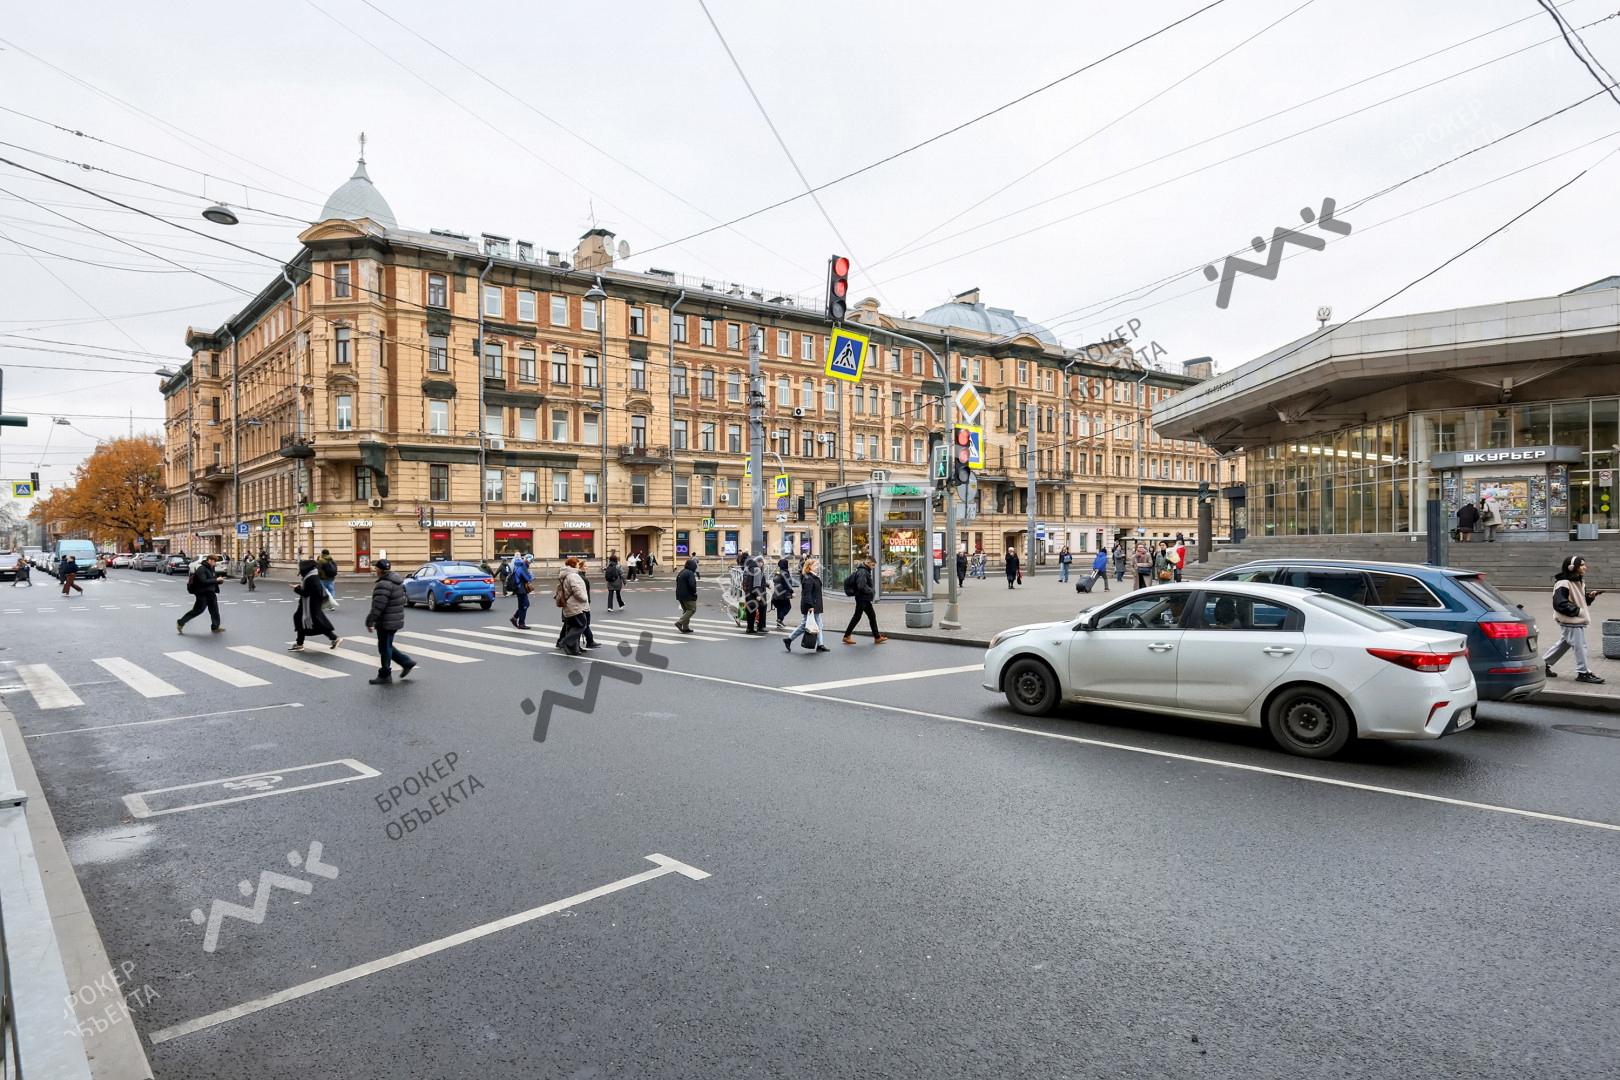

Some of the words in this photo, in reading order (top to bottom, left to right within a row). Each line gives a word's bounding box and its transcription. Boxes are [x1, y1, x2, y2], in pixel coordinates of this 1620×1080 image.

[1475, 450, 1546, 462] КУРЬЕР
[885, 485, 920, 495] ЦВЕТЫ
[563, 521, 592, 529] ПЕКАРНЯ
[889, 537, 918, 546] ОРАНЖ
[889, 545, 918, 553] ЦВЕТЫ
